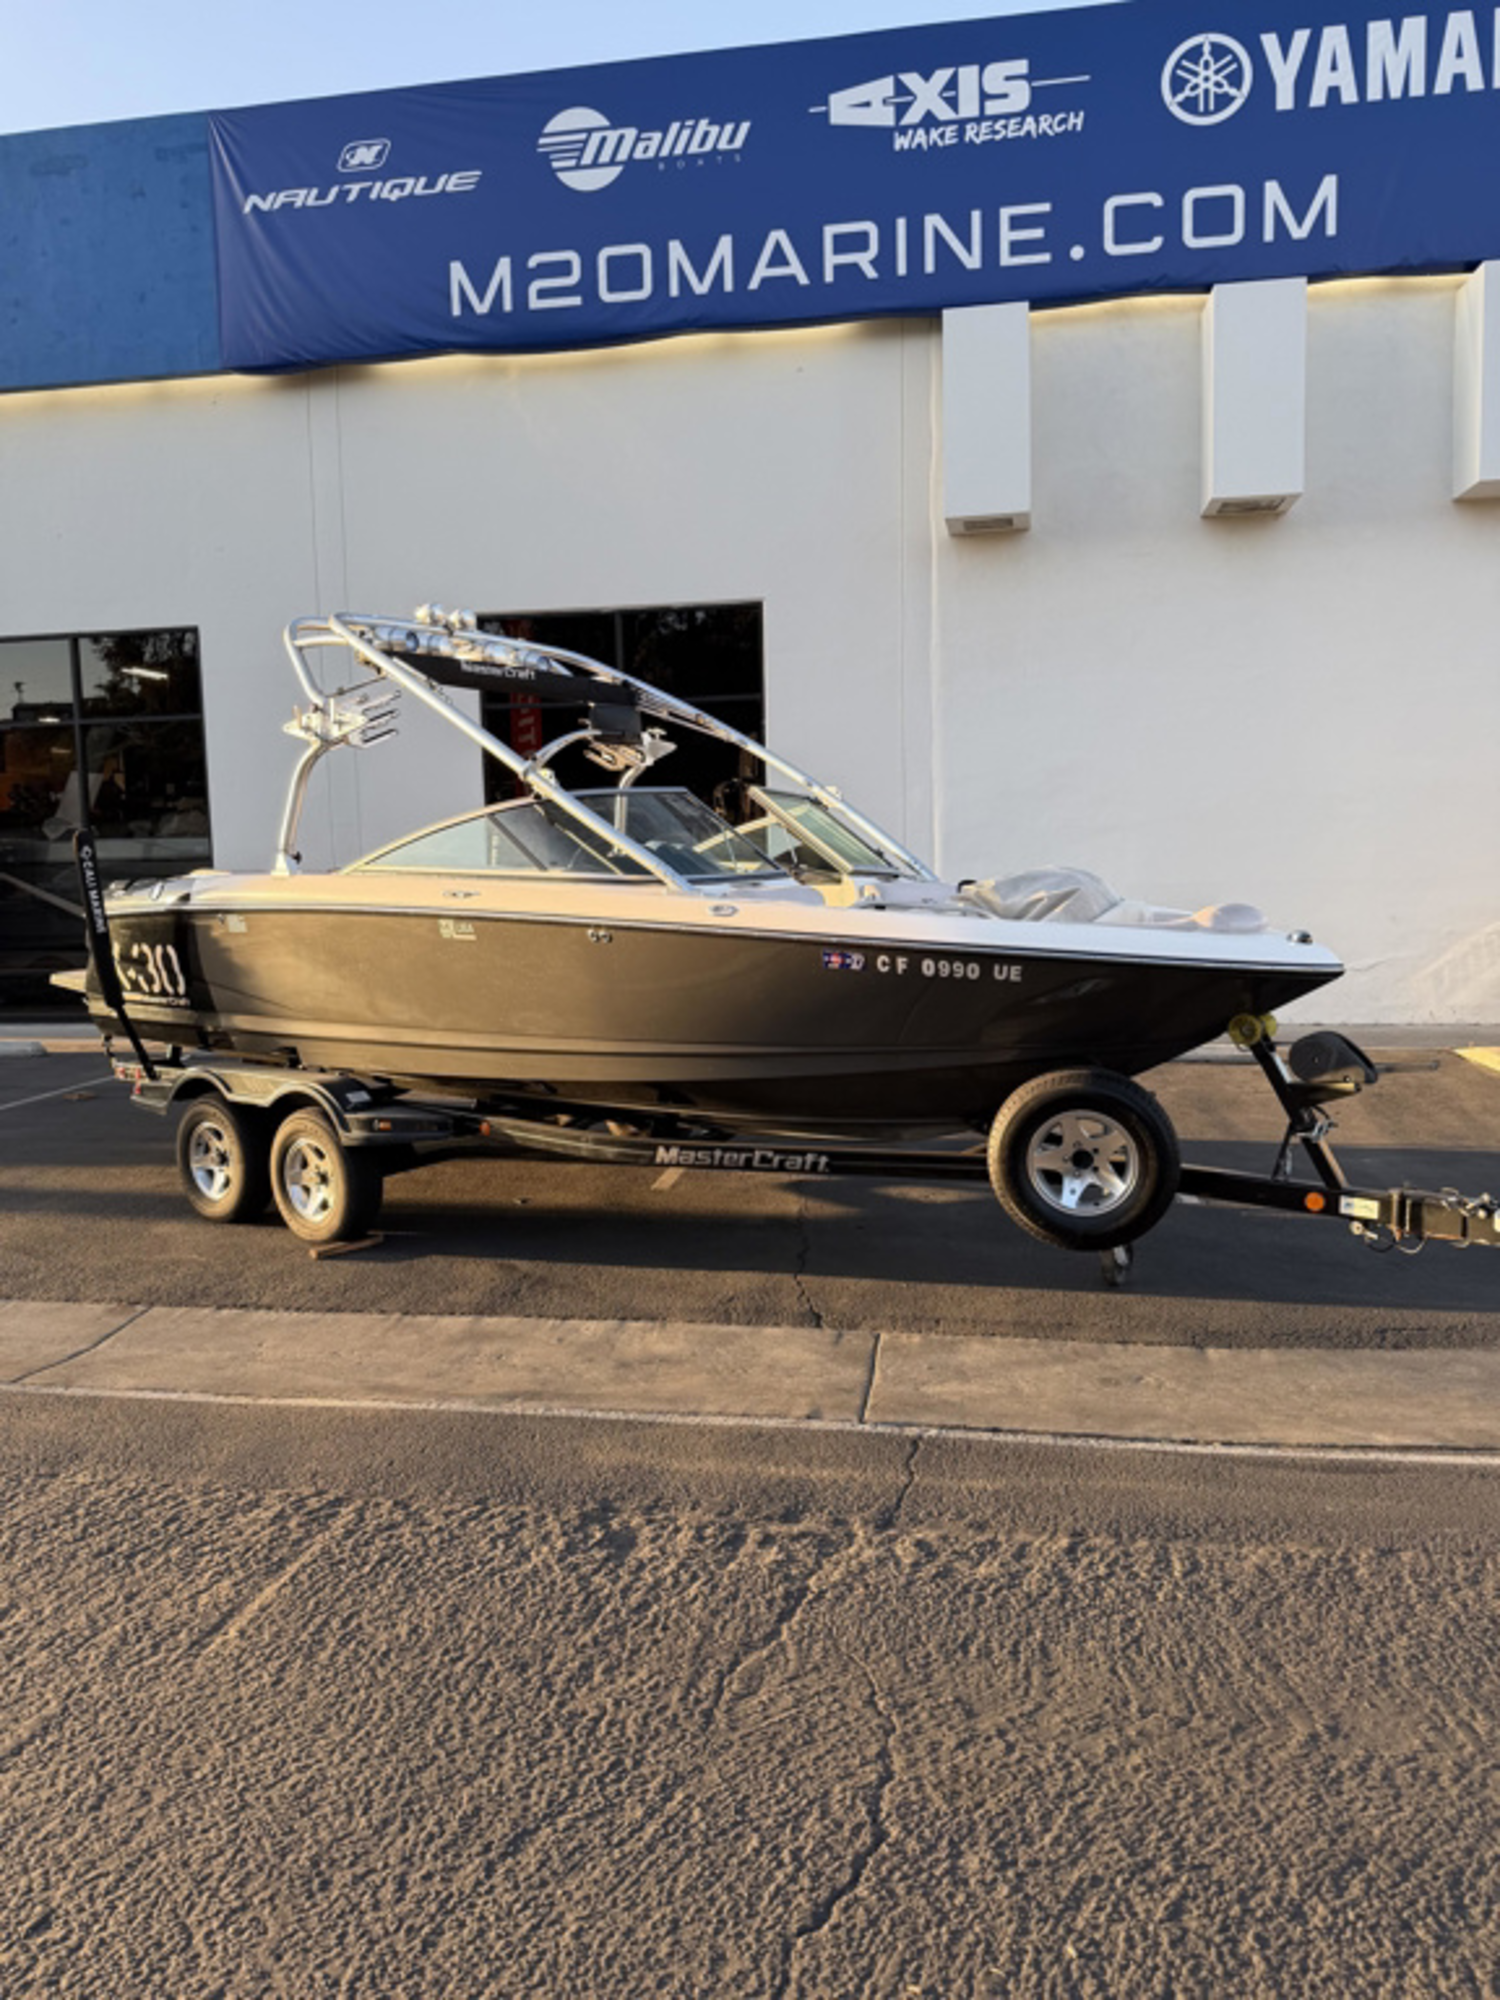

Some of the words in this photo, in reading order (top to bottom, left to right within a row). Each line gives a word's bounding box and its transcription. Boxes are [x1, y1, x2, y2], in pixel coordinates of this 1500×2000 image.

[1260, 8, 1500, 111] YAMA
[828, 59, 1031, 126] AXIS
[894, 124, 959, 151] WAKE
[964, 111, 1085, 144] RESEARCH
[243, 170, 482, 214] NAUTIQUE
[921, 958, 981, 980] 0990
[993, 964, 1023, 982] UE
[655, 1145, 830, 1172] MasterCraft
